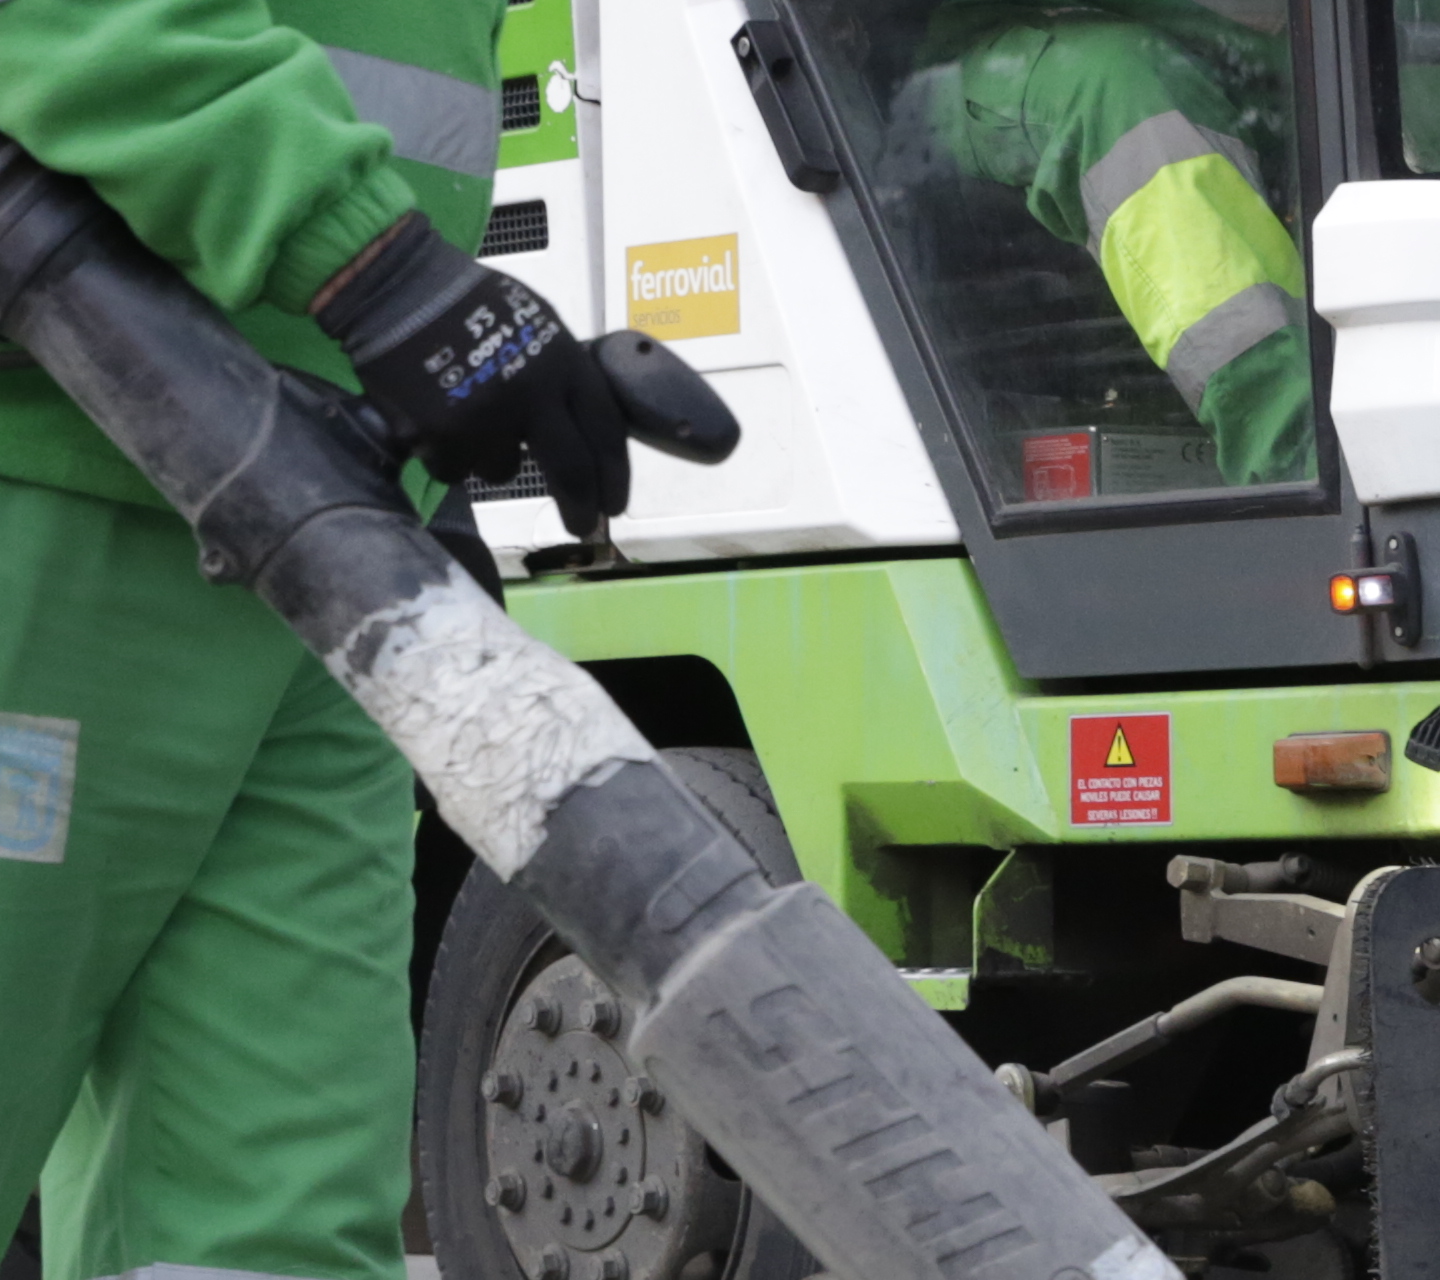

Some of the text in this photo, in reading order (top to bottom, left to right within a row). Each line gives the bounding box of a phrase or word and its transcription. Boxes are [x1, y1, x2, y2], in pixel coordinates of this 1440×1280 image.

[631, 250, 736, 302] ferrovial
[633, 308, 682, 328] servicios
[1077, 776, 1163, 789] EL CONTACTO CON PIEZAS
[1109, 790, 1131, 802] PUEDE
[1133, 789, 1160, 801] CAUSAR
[1087, 809, 1118, 821] SEVERAS
